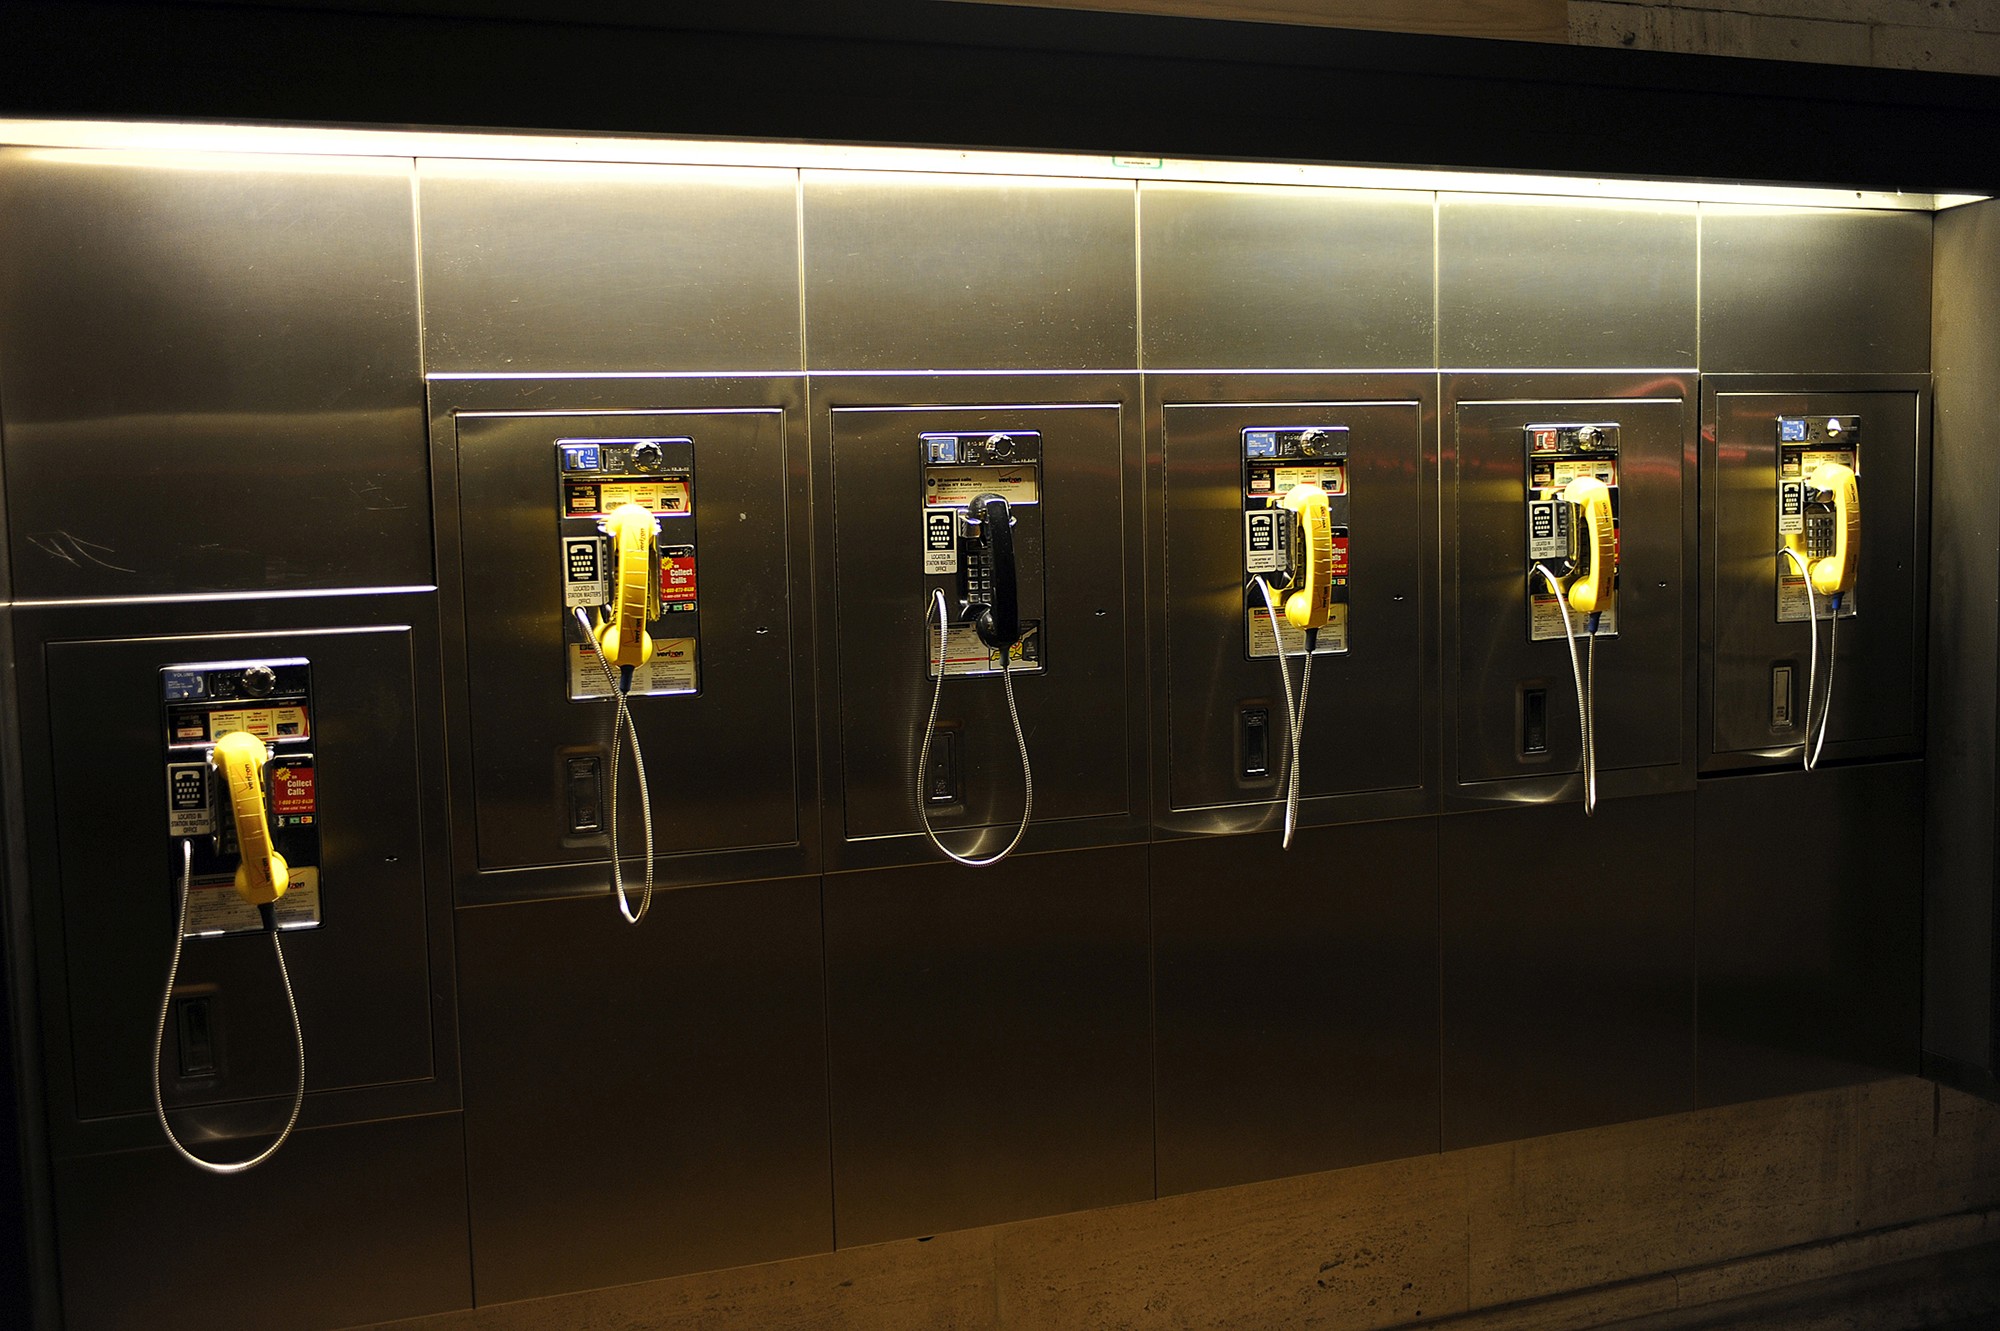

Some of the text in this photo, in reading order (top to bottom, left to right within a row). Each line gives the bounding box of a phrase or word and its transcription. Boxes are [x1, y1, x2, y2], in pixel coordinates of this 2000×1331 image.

[244, 764, 254, 790] verizon
[287, 780, 312, 788] Collect
[287, 788, 306, 796] Calls
[288, 881, 305, 889] izon
